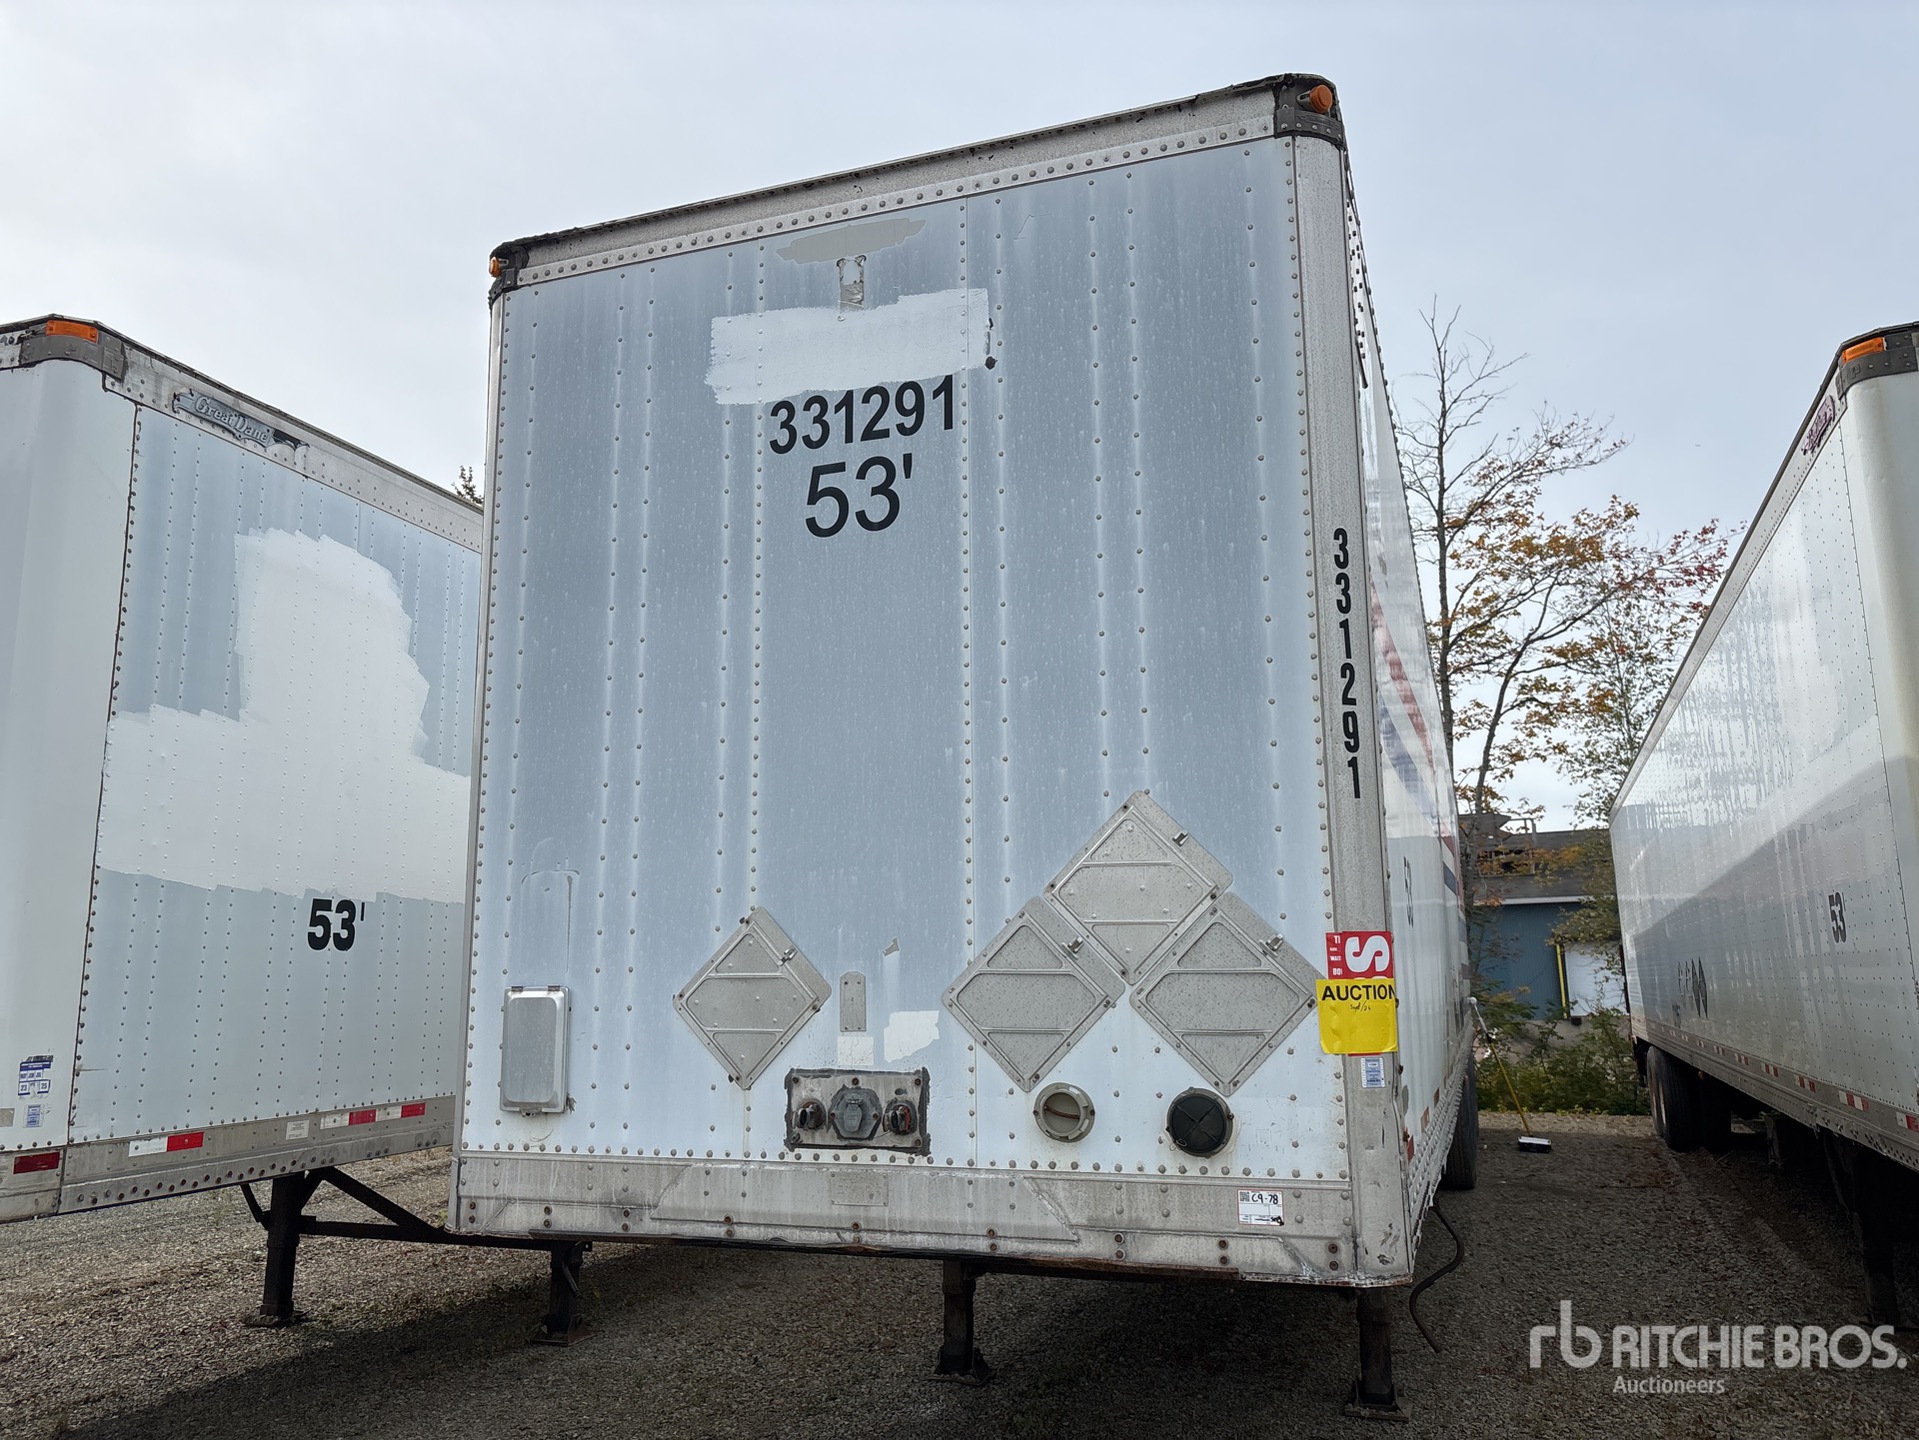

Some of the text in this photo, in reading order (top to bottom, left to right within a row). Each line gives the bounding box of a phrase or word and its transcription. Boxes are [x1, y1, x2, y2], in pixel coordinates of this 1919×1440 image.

[195, 396, 269, 441] Great Dane
[769, 374, 954, 455] 331291
[804, 452, 914, 538] 53'
[1333, 527, 1361, 800] 331291
[307, 898, 366, 951] 53'
[1321, 984, 1396, 1001] AUCTION
[1251, 1193, 1279, 1205] C9-78
